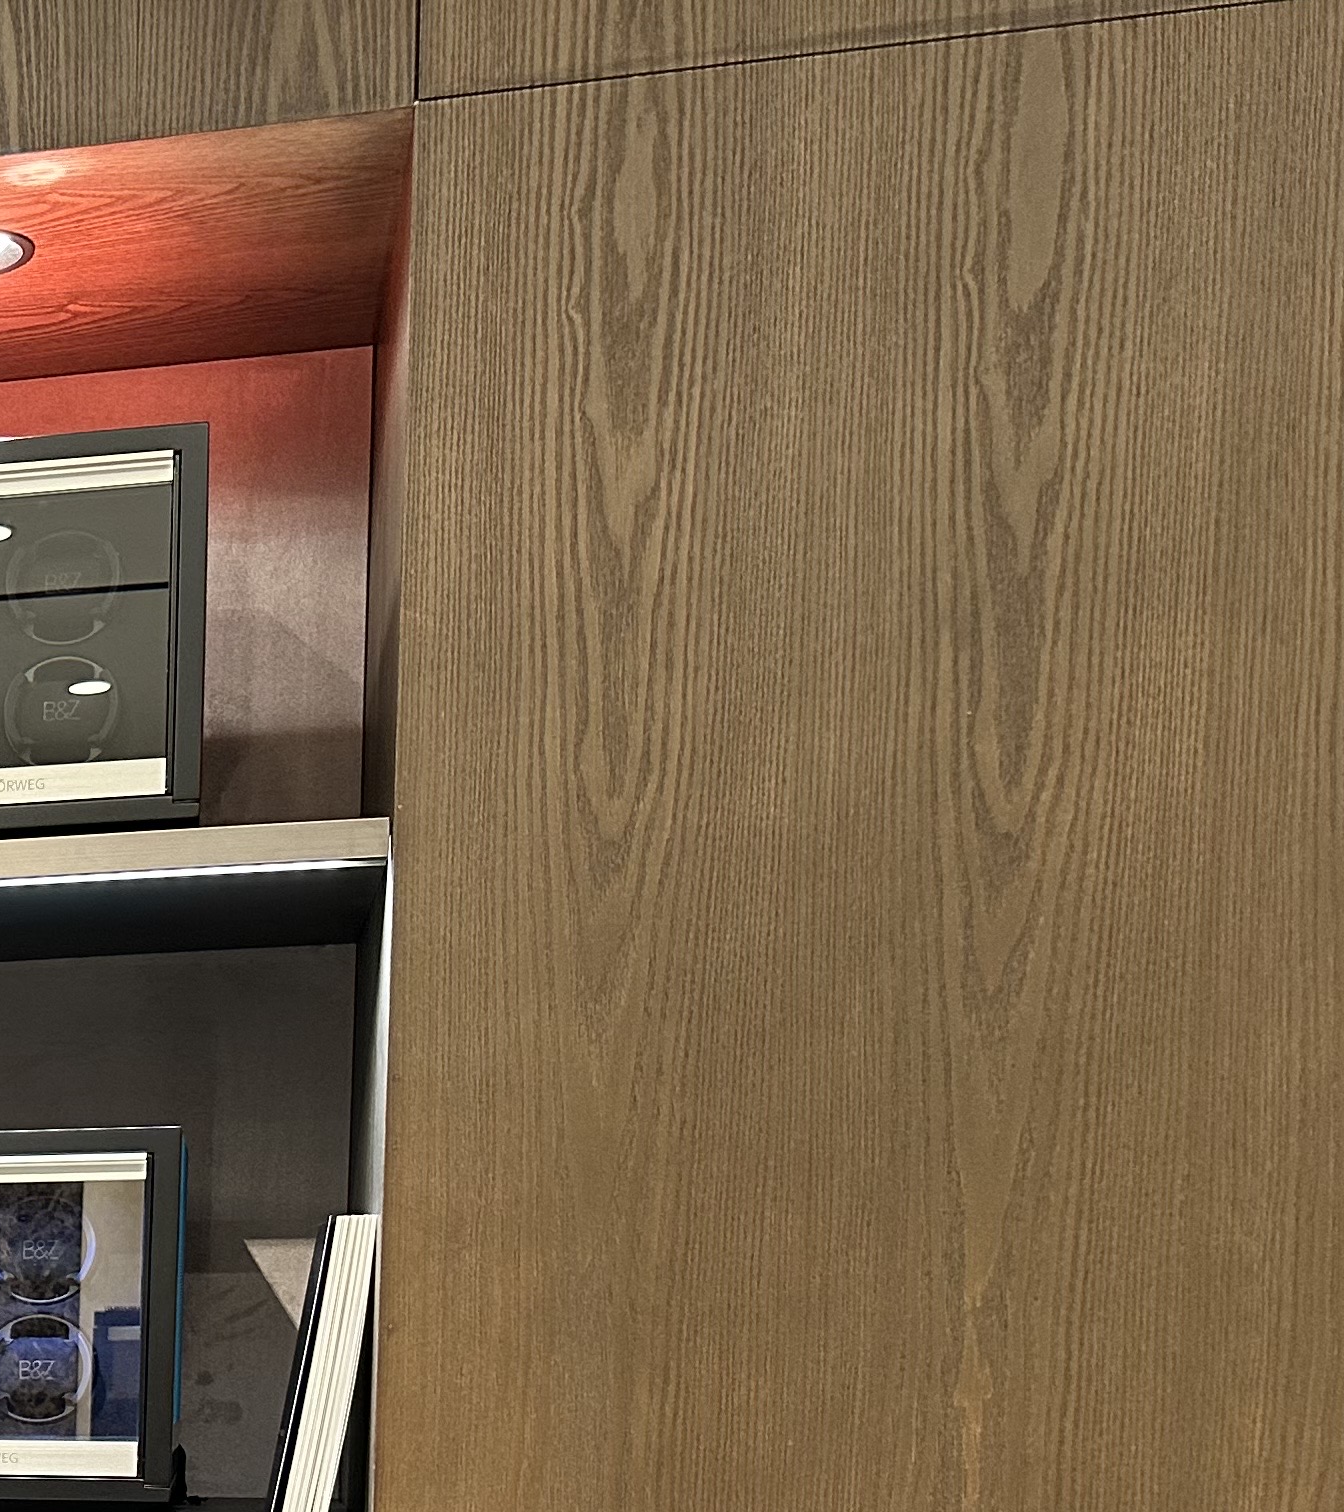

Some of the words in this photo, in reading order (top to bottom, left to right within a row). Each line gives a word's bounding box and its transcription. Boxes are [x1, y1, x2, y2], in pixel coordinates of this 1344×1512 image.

[43, 700, 81, 721] B&Z
[23, 1239, 60, 1260] B&Z
[19, 1360, 56, 1381] B&Z
